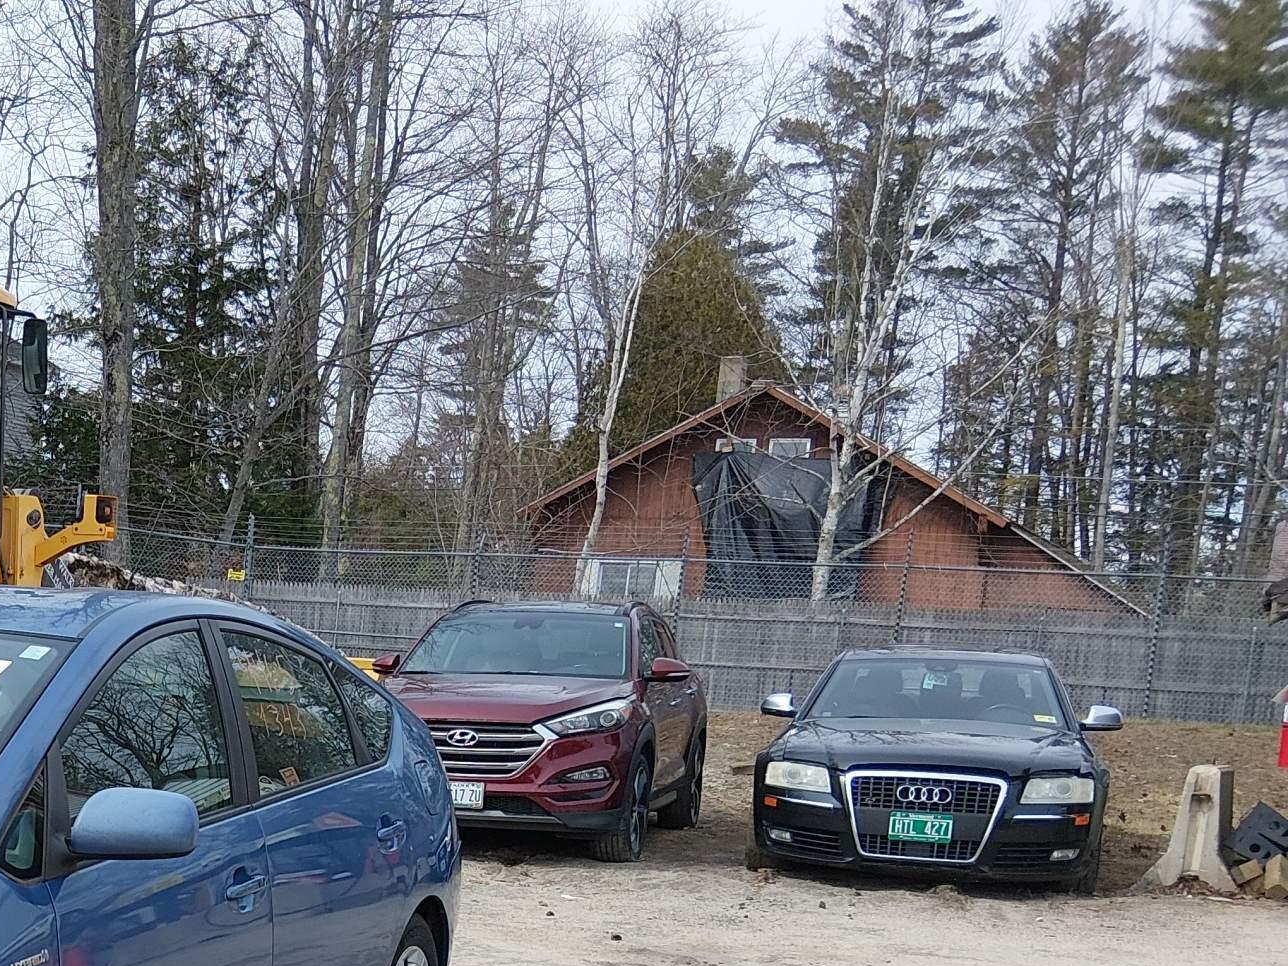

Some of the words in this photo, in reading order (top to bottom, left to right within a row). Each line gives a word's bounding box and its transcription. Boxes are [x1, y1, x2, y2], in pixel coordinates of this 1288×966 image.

[450, 789, 465, 801] 17
[469, 789, 480, 801] ZU
[895, 819, 916, 834] HTL
[924, 821, 947, 836] 427
